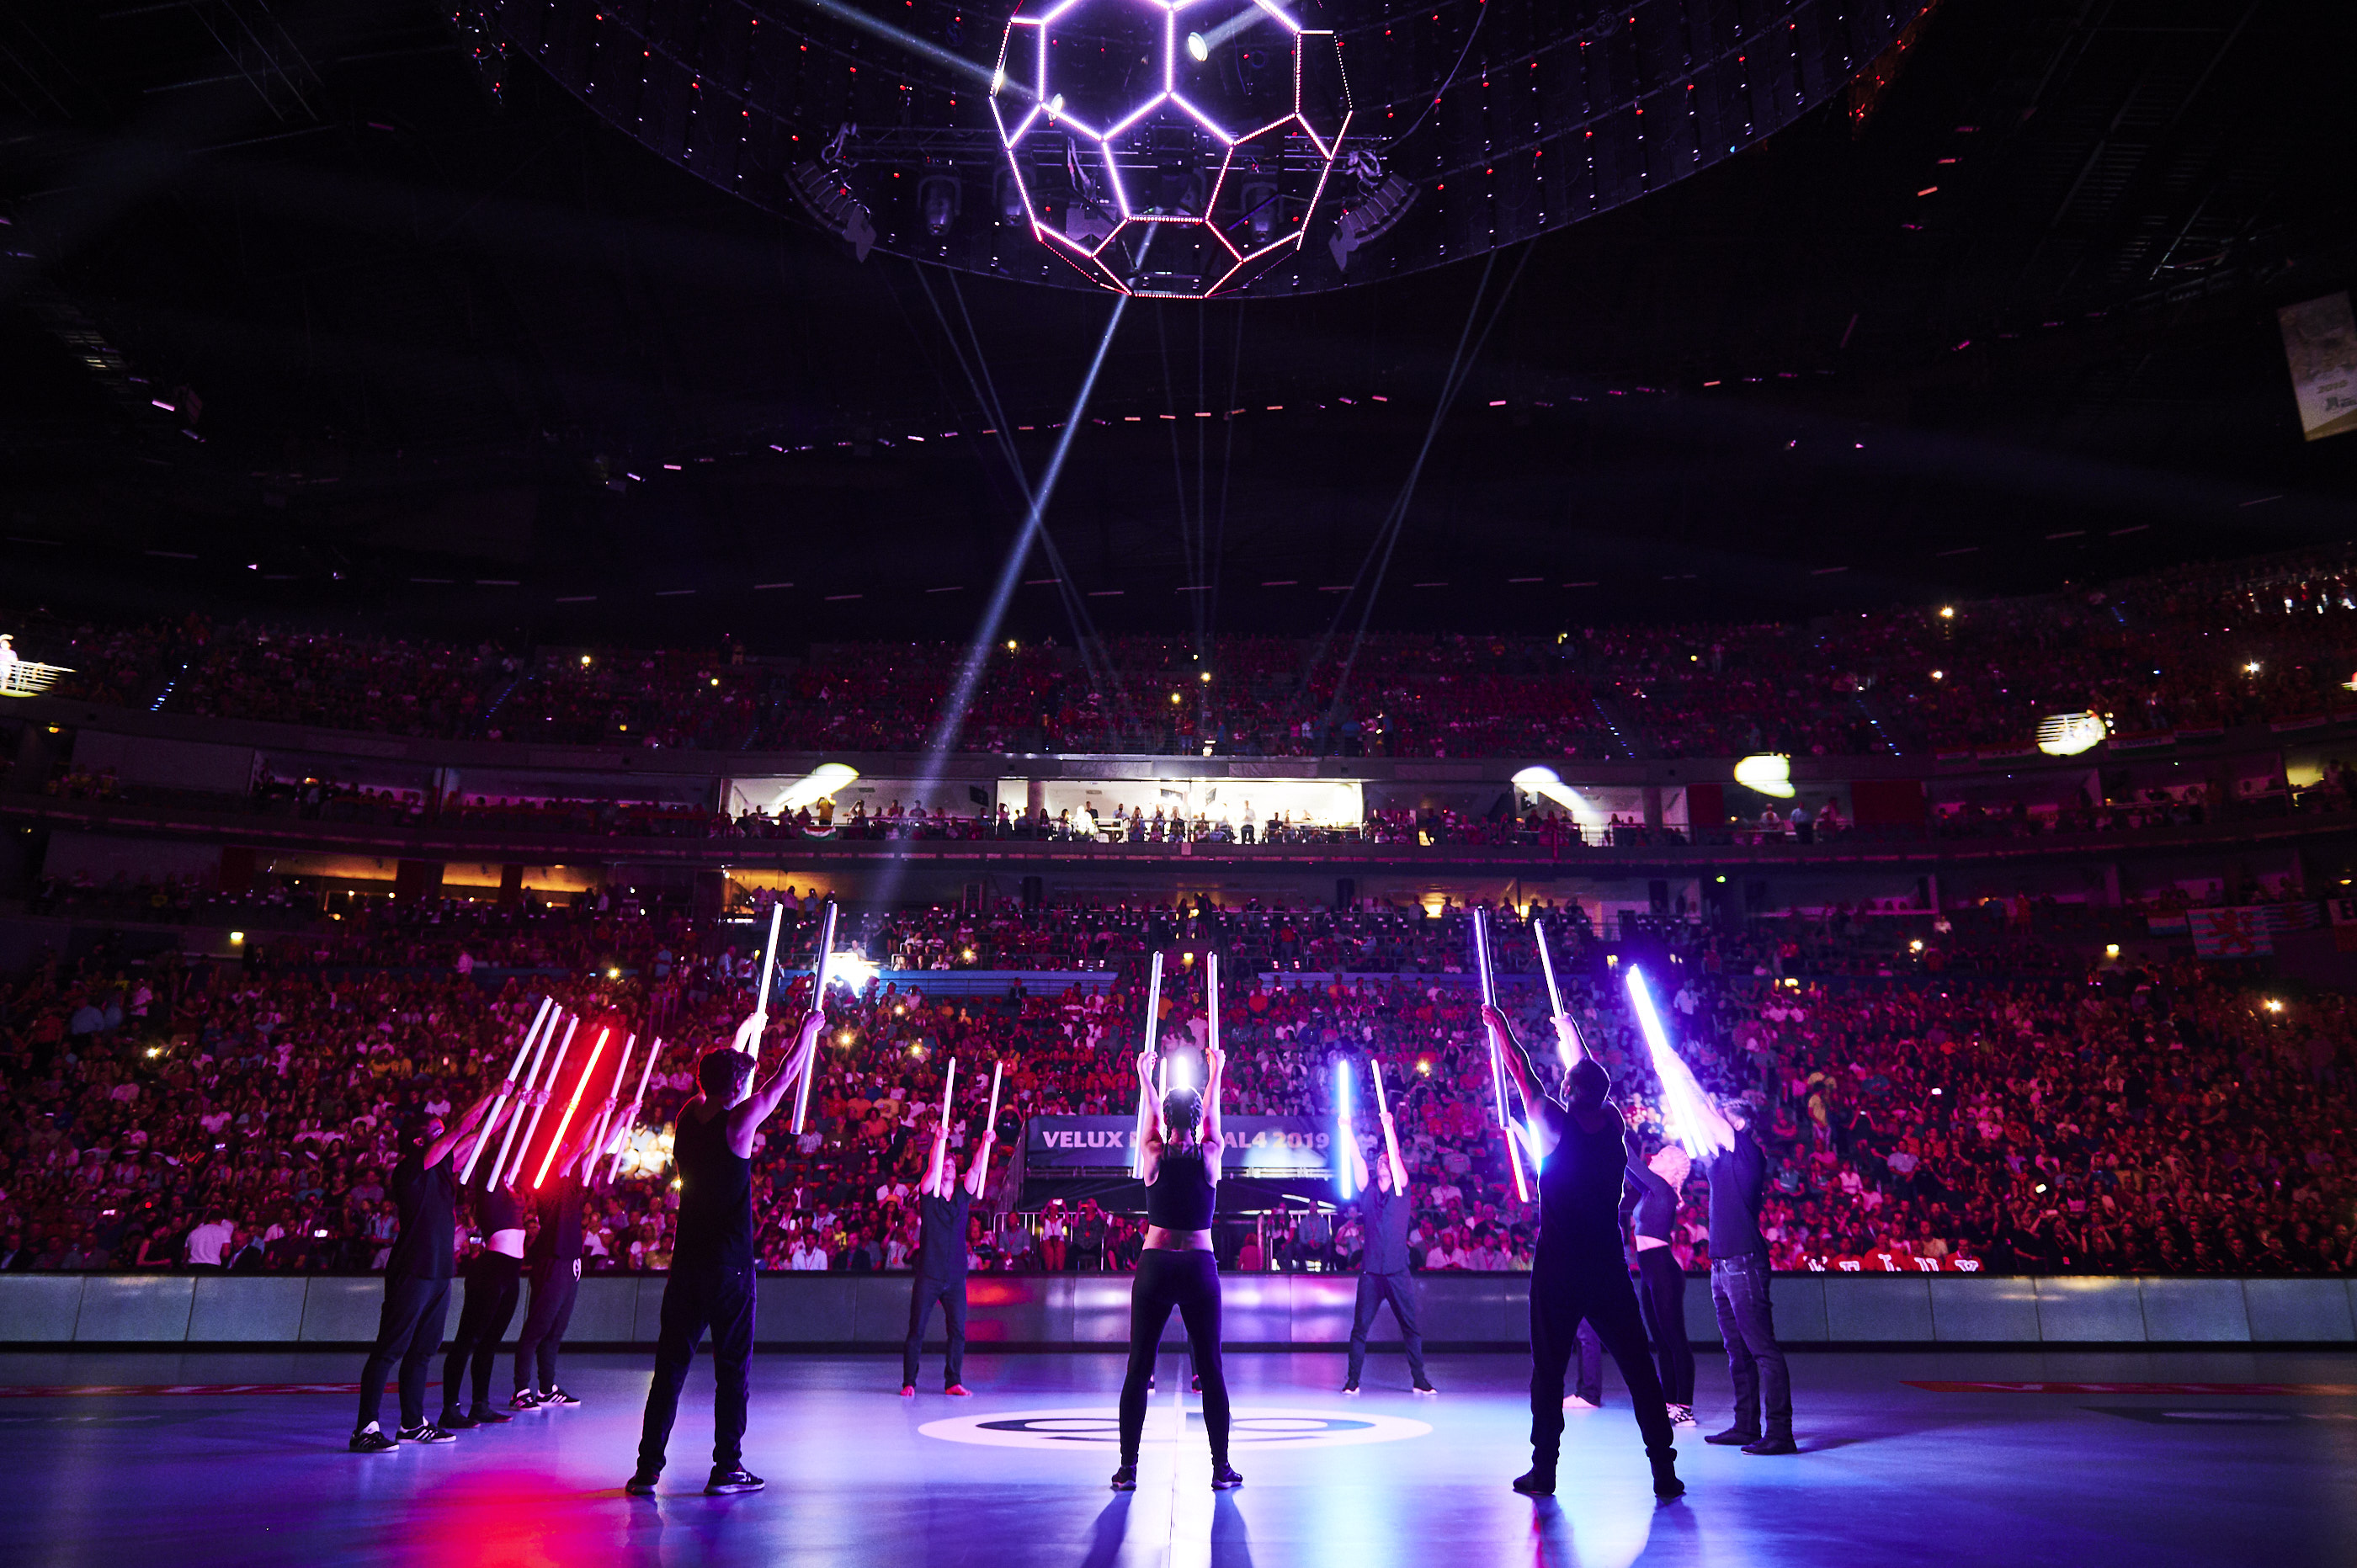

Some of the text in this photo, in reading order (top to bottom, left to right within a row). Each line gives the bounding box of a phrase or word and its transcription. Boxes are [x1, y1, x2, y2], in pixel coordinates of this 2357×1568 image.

[1042, 1130, 1124, 1148] VELUX
[1223, 1131, 1267, 1149] AL4
[1272, 1131, 1330, 1149] 2019
